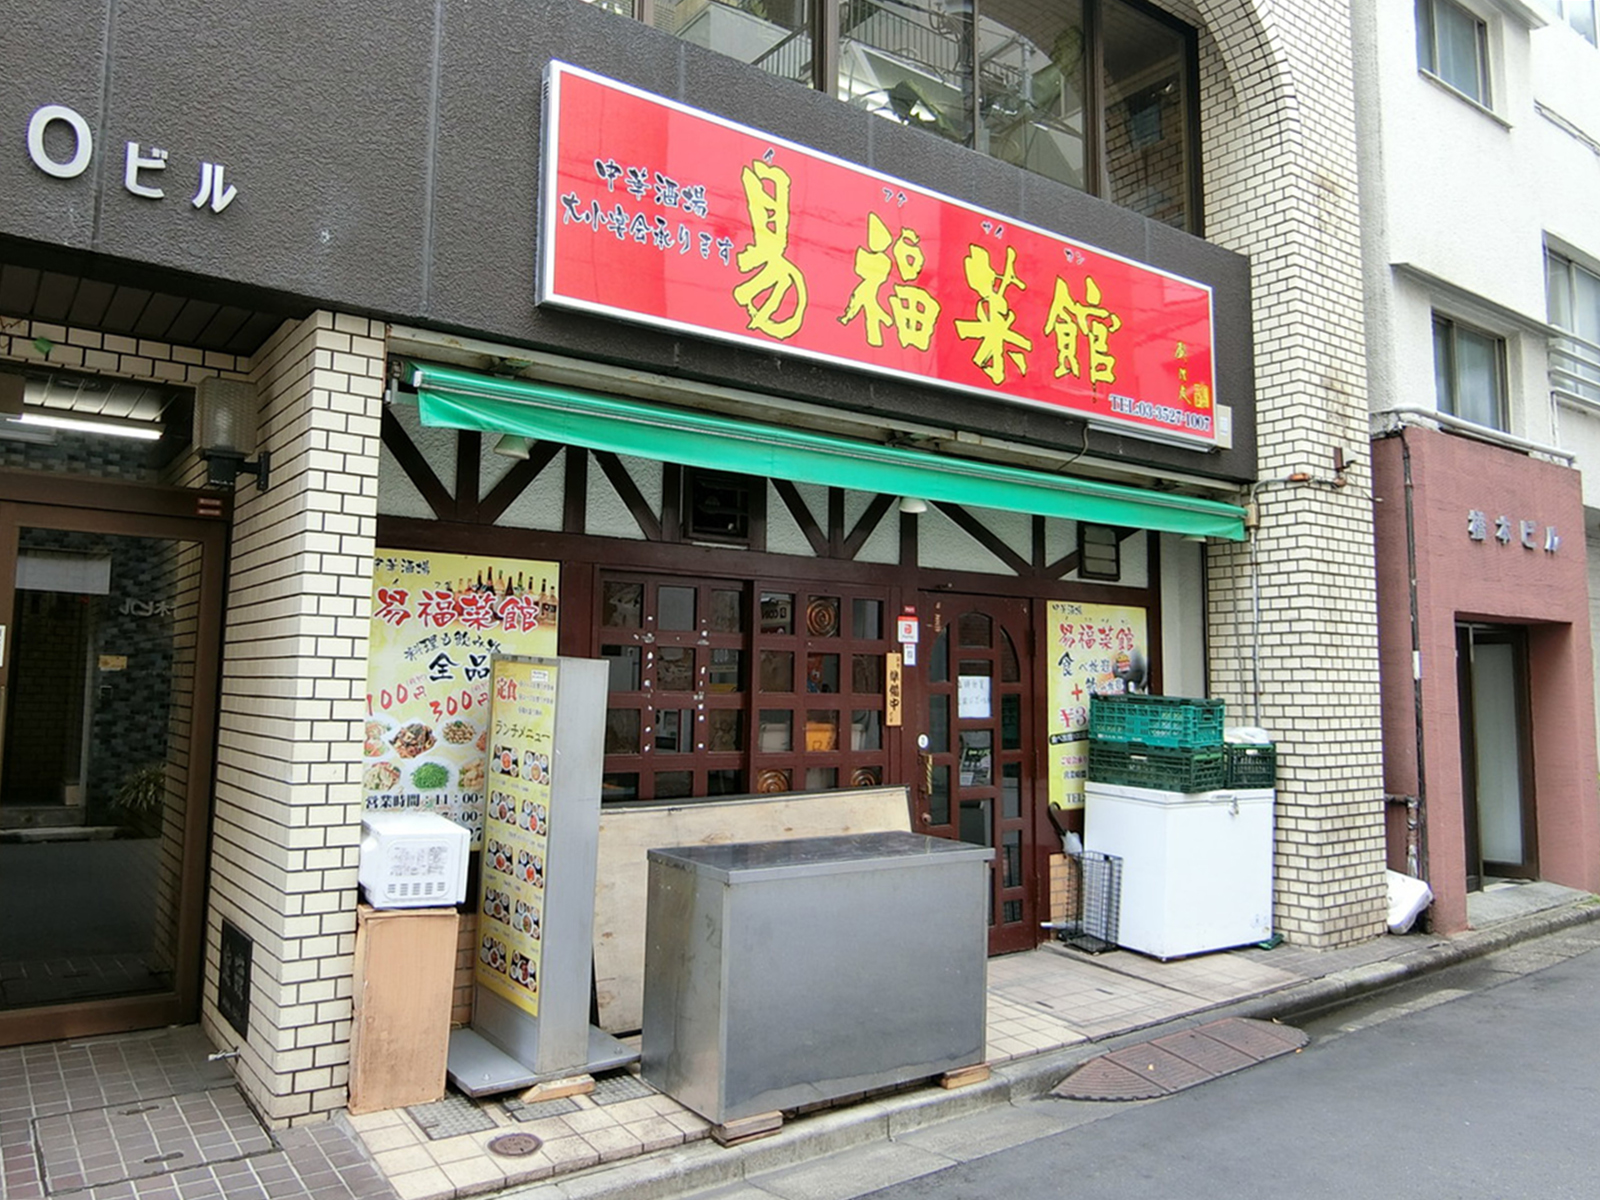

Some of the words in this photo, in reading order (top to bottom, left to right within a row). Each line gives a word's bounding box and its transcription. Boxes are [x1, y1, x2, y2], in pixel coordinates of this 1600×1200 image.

[594, 157, 709, 219] 中華酒場
[560, 191, 736, 265] 大小宴会承ります
[732, 159, 1123, 386] 易福菜館
[373, 587, 540, 633] 易福菜館
[1058, 623, 1135, 651] 易福菜館
[428, 652, 491, 682] 全品
[496, 677, 518, 701] 定食
[495, 719, 551, 743] ランチメニュー
